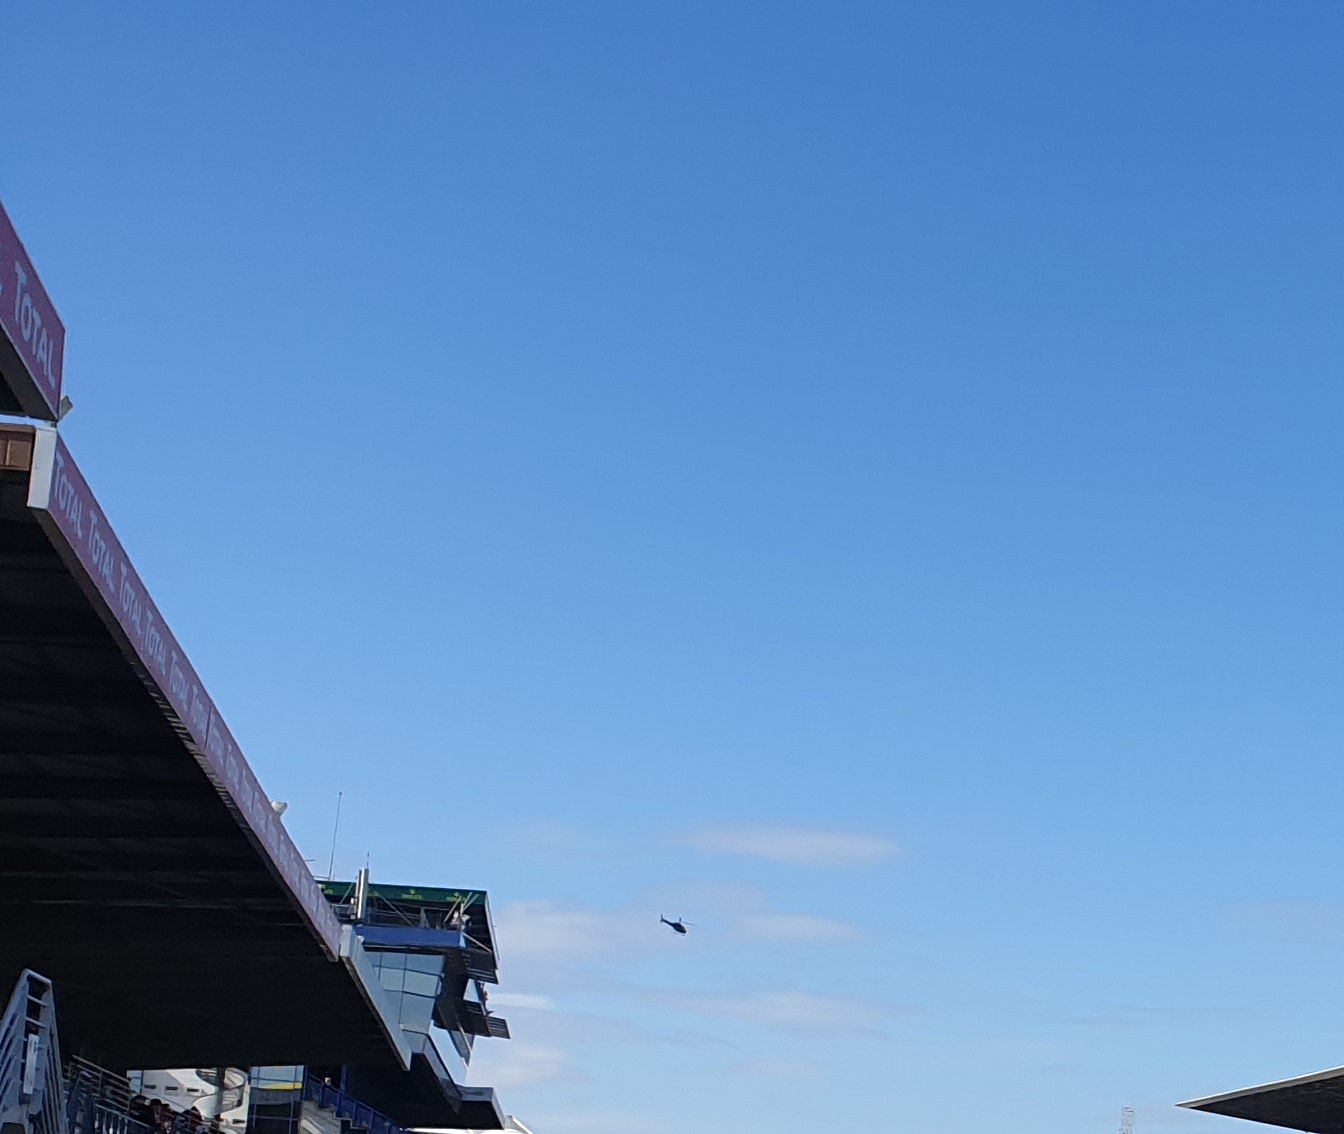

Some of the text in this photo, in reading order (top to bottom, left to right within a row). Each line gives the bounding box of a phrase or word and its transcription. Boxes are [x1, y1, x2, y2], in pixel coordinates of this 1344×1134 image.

[14, 260, 56, 390] TOTAL
[54, 452, 83, 540] TOTAL
[87, 509, 115, 594] TOTAL
